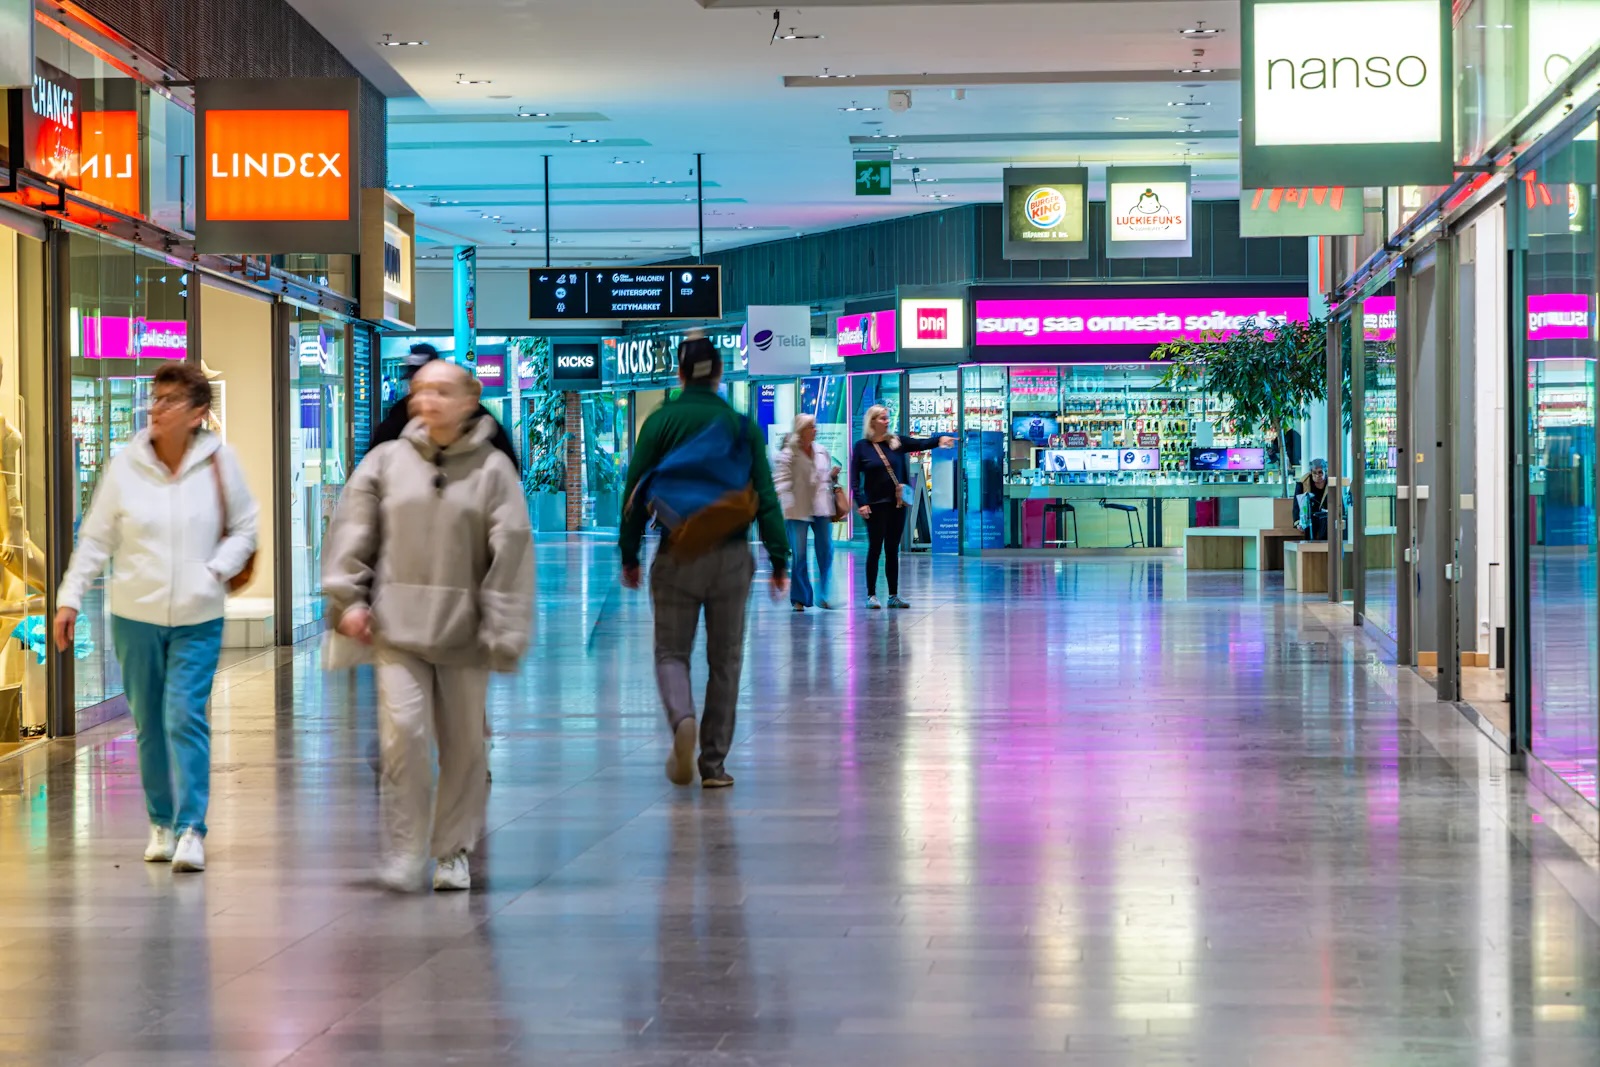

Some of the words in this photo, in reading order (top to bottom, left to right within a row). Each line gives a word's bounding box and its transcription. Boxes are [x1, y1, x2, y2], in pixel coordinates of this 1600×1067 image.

[1267, 54, 1427, 90] nanso
[32, 74, 74, 129] CHANGE
[212, 152, 342, 179] LINDEX
[1030, 195, 1060, 209] BURGER
[1031, 202, 1061, 220] KING
[1116, 215, 1182, 225] LUCKIEFUN'S
[618, 289, 661, 297] INTERSPORT
[919, 316, 945, 331] DNA
[1043, 316, 1083, 332] saa
[1086, 313, 1180, 332] onnesta
[776, 334, 806, 347] Telia
[558, 355, 595, 368] KICKS
[617, 338, 653, 375] KICKS
